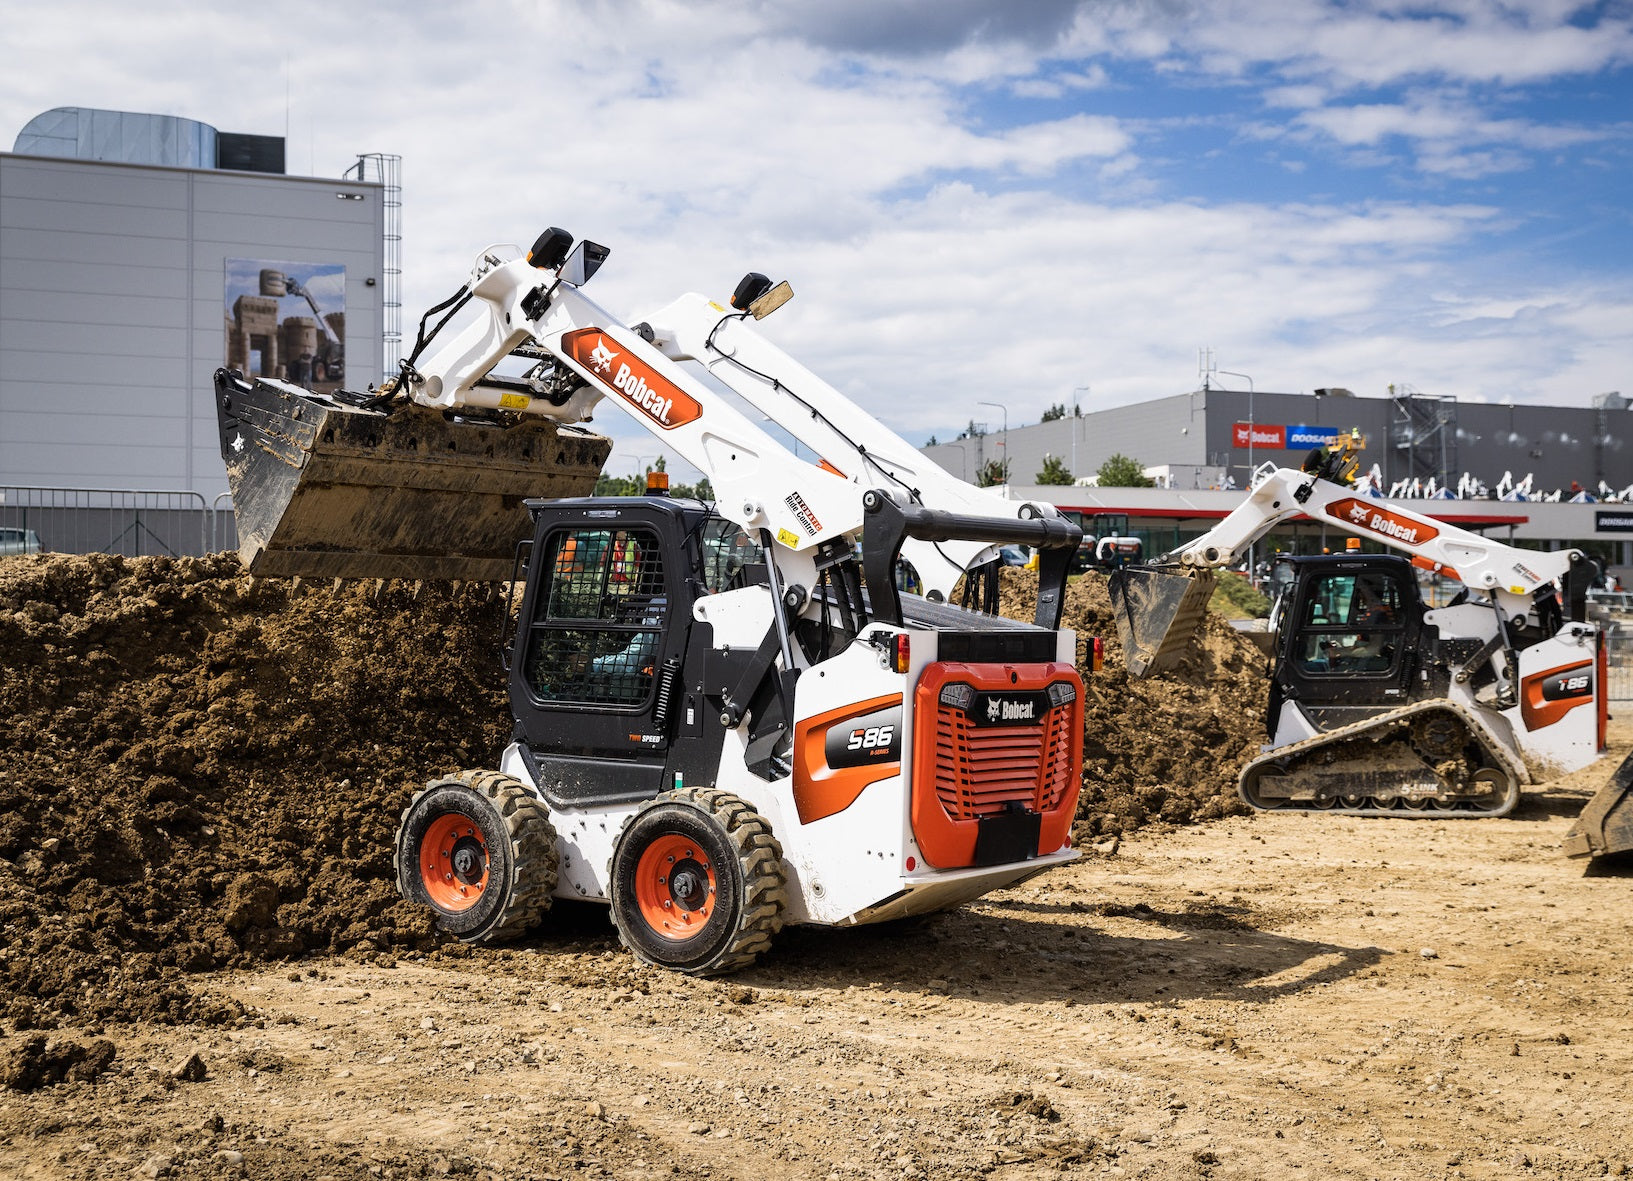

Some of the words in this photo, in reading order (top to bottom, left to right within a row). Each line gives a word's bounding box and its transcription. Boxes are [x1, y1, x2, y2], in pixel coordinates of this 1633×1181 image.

[613, 362, 673, 423] Bobcat
[1251, 432, 1280, 443] Bobcat
[785, 495, 799, 512] Ride
[796, 511, 817, 537] Control
[791, 491, 823, 532] AUTOMATIC
[1370, 513, 1417, 543] Bobcat
[1558, 676, 1589, 691] T86
[1002, 700, 1033, 719] Bobcat
[848, 726, 894, 749] S86
